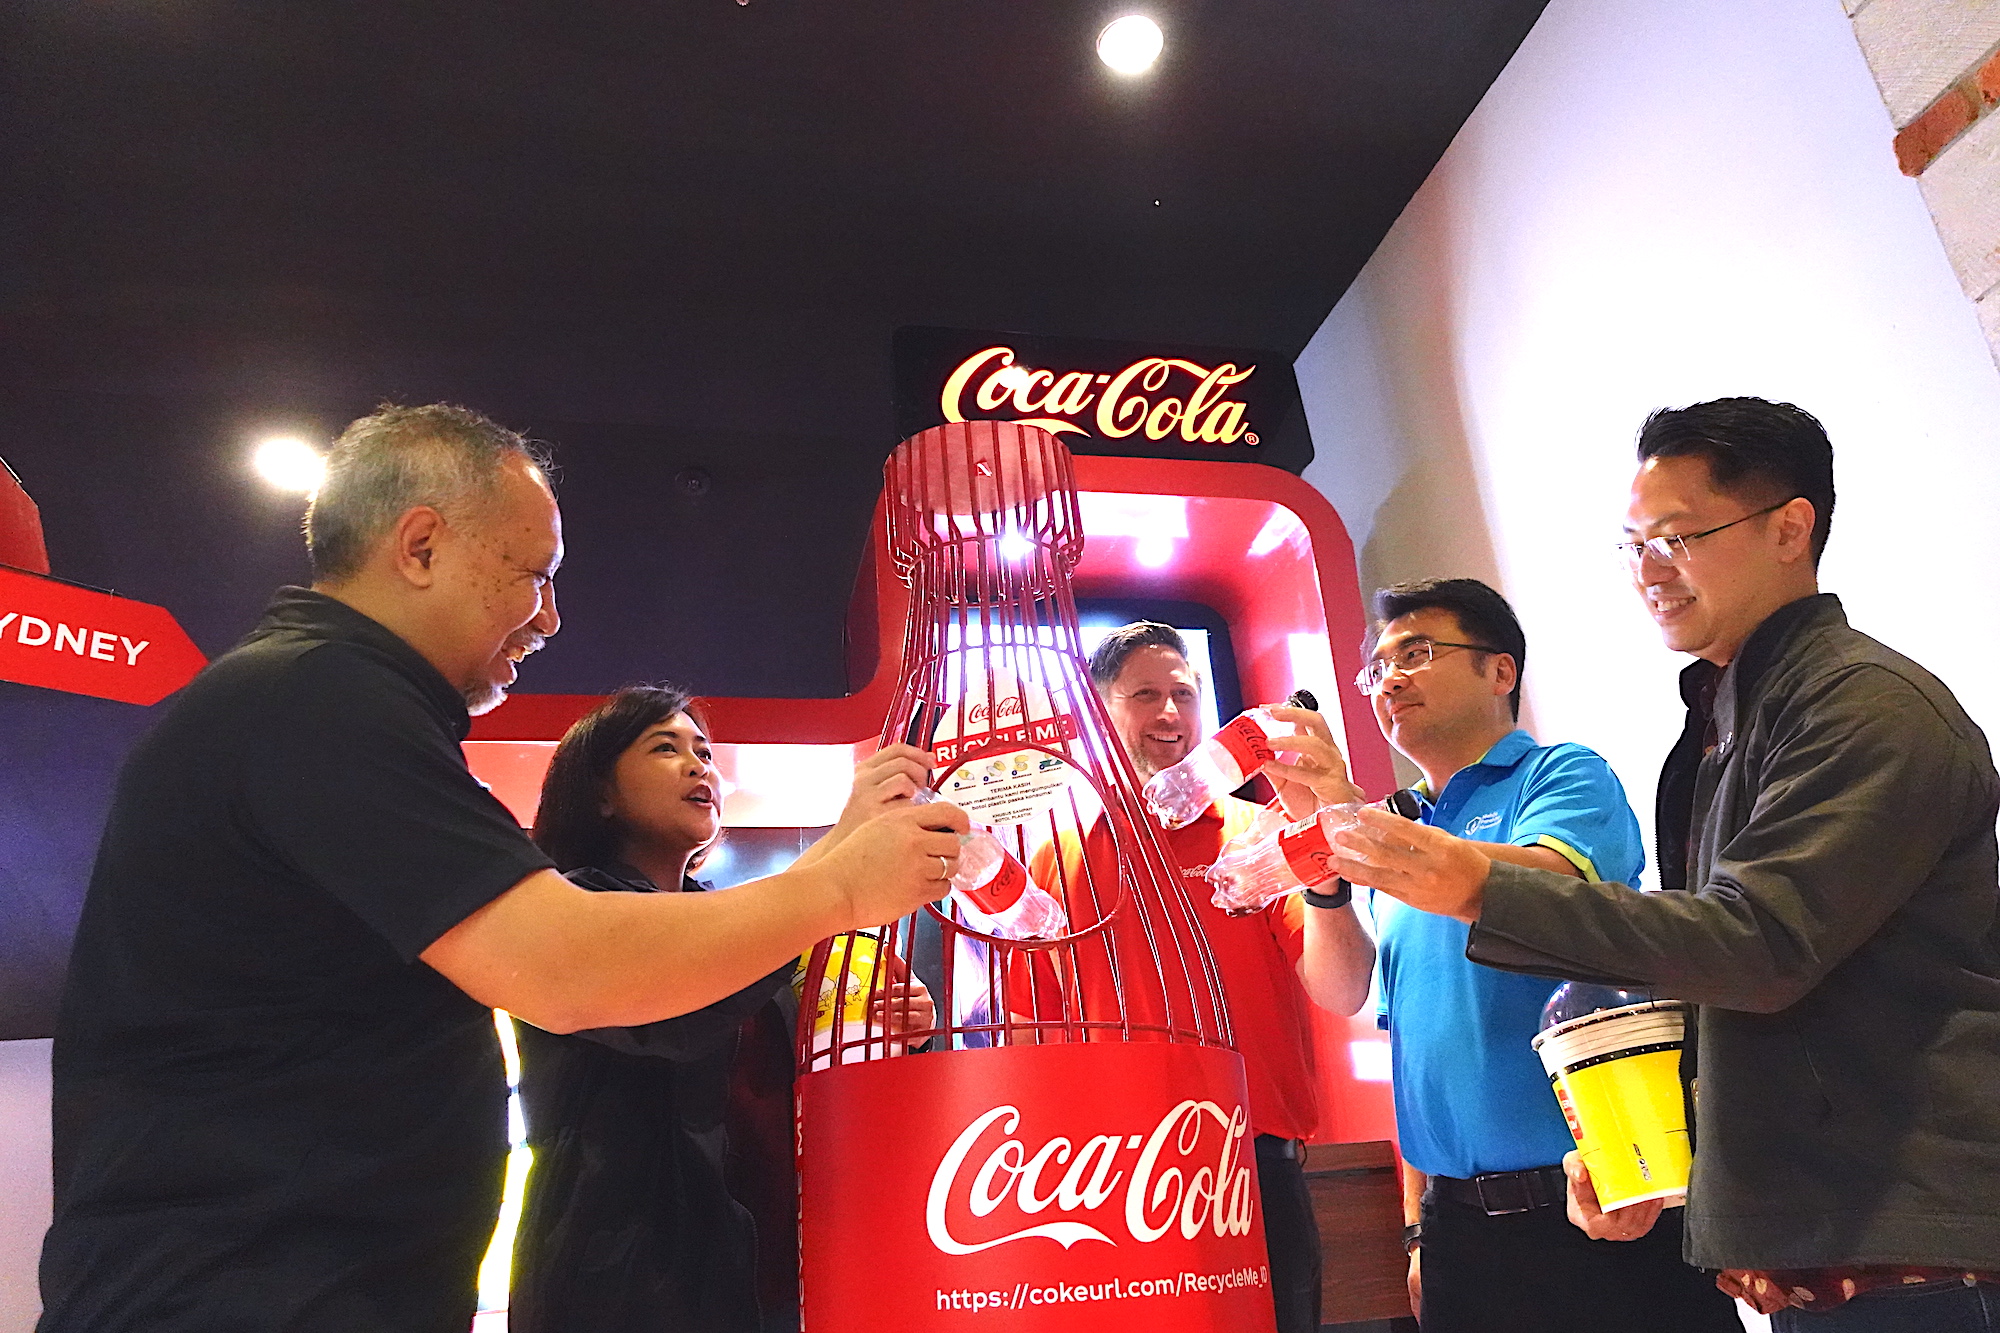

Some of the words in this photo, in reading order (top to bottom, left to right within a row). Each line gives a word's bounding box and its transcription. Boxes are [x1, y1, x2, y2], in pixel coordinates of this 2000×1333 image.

[941, 347, 1256, 444] Coca-Cola
[969, 696, 1022, 723] Coc-Cola
[990, 786, 1012, 794] TERIMA
[926, 1100, 1254, 1256] Coca-Cola
[936, 1266, 1268, 1313] https://cokeurl.com/RecycleMe_ID
